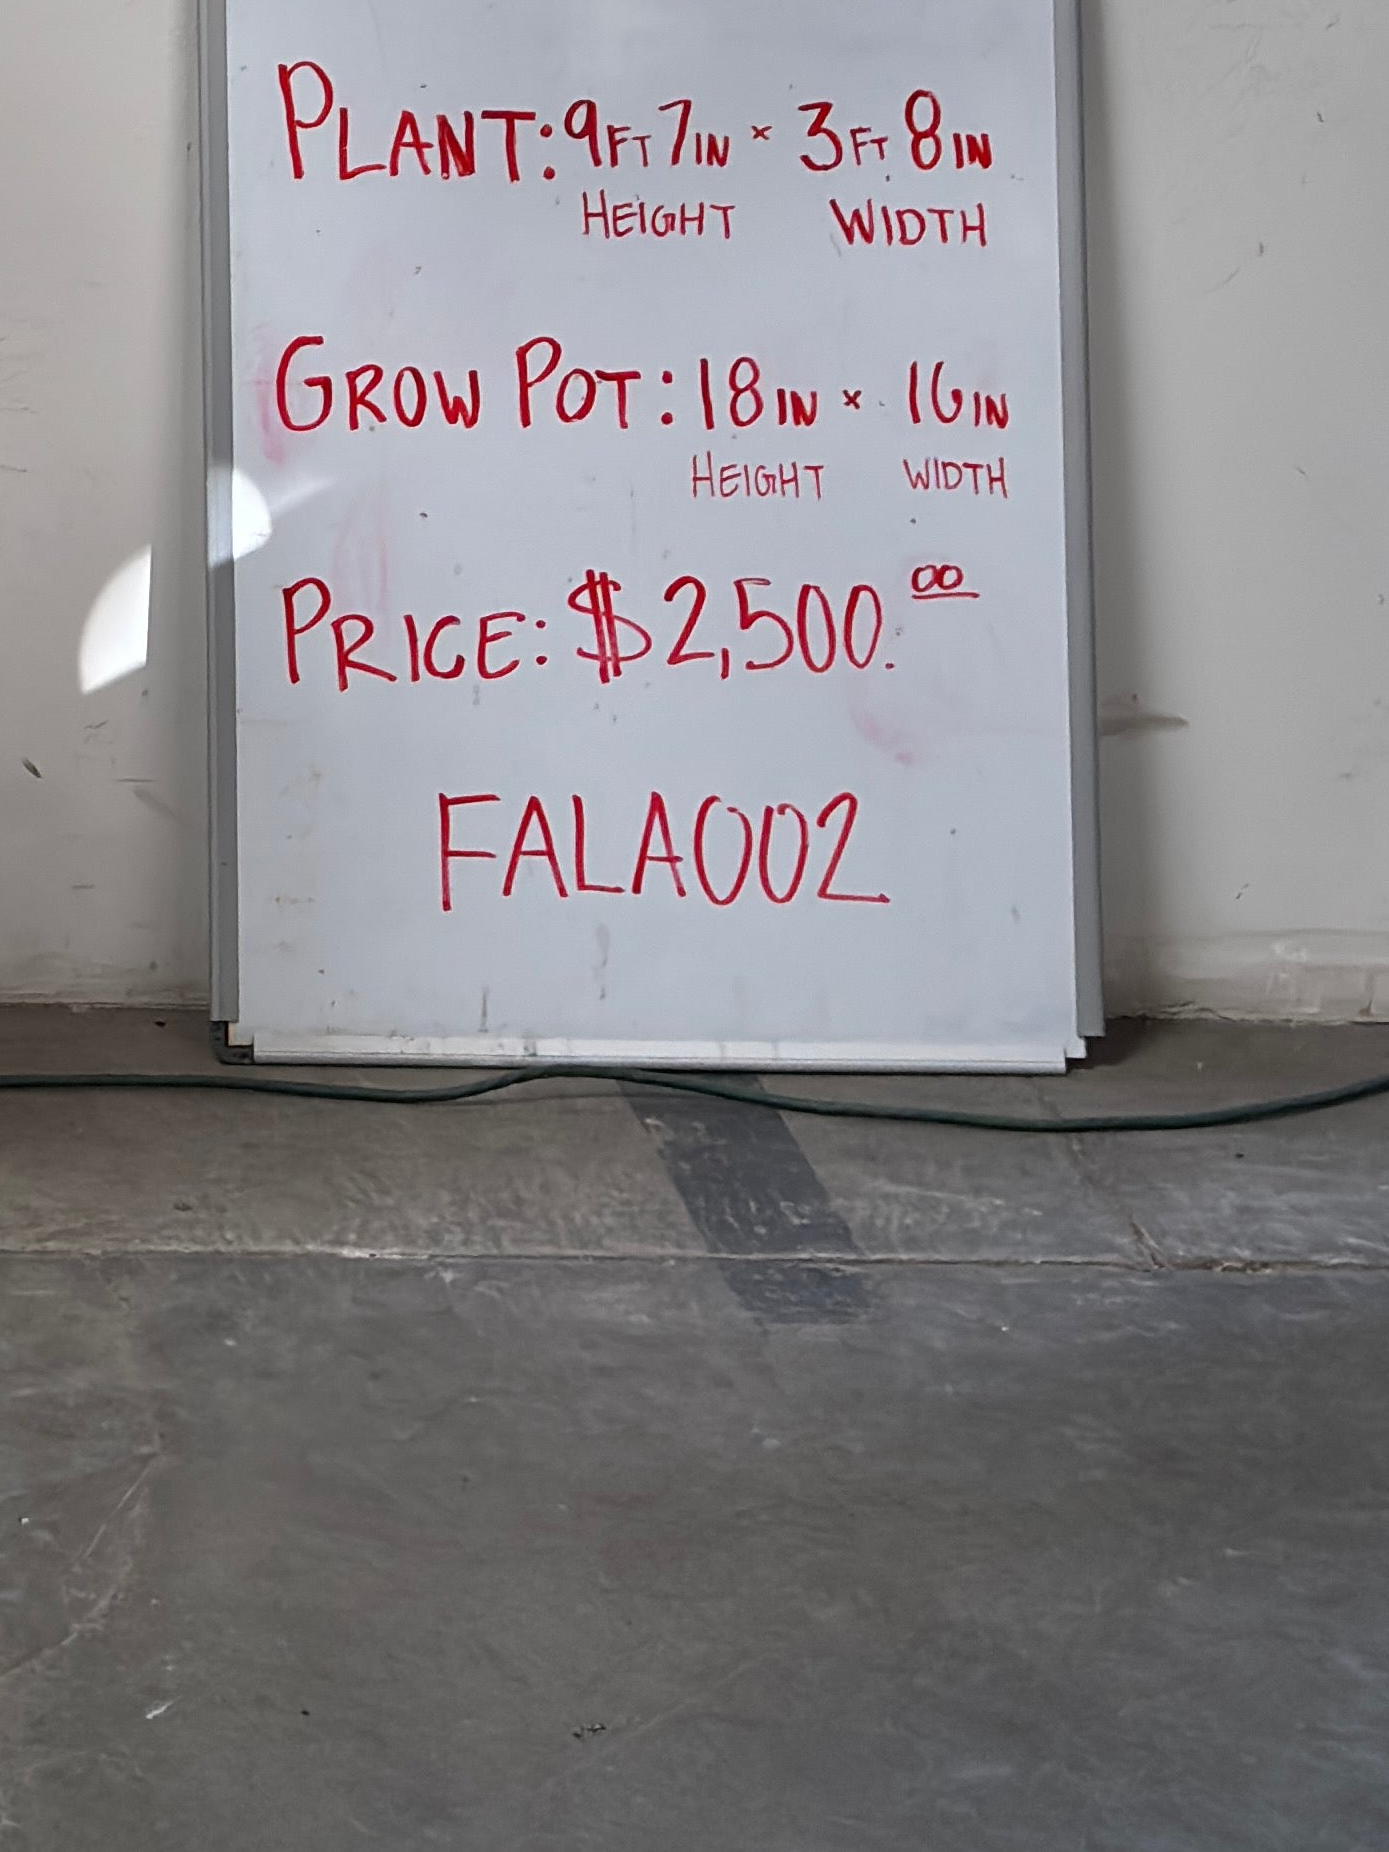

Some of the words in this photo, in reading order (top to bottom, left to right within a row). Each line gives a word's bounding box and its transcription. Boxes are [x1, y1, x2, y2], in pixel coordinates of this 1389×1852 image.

[276, 60, 557, 183] PLANT:
[581, 190, 734, 240] HEIGHT
[829, 199, 987, 248] WIDTH
[273, 335, 481, 434] GROW
[513, 336, 674, 431] POT:
[691, 452, 823, 499] HEIGHT
[902, 458, 1007, 498] WIDTH
[281, 576, 548, 693] PRICE:
[437, 791, 890, 913] FALA002
